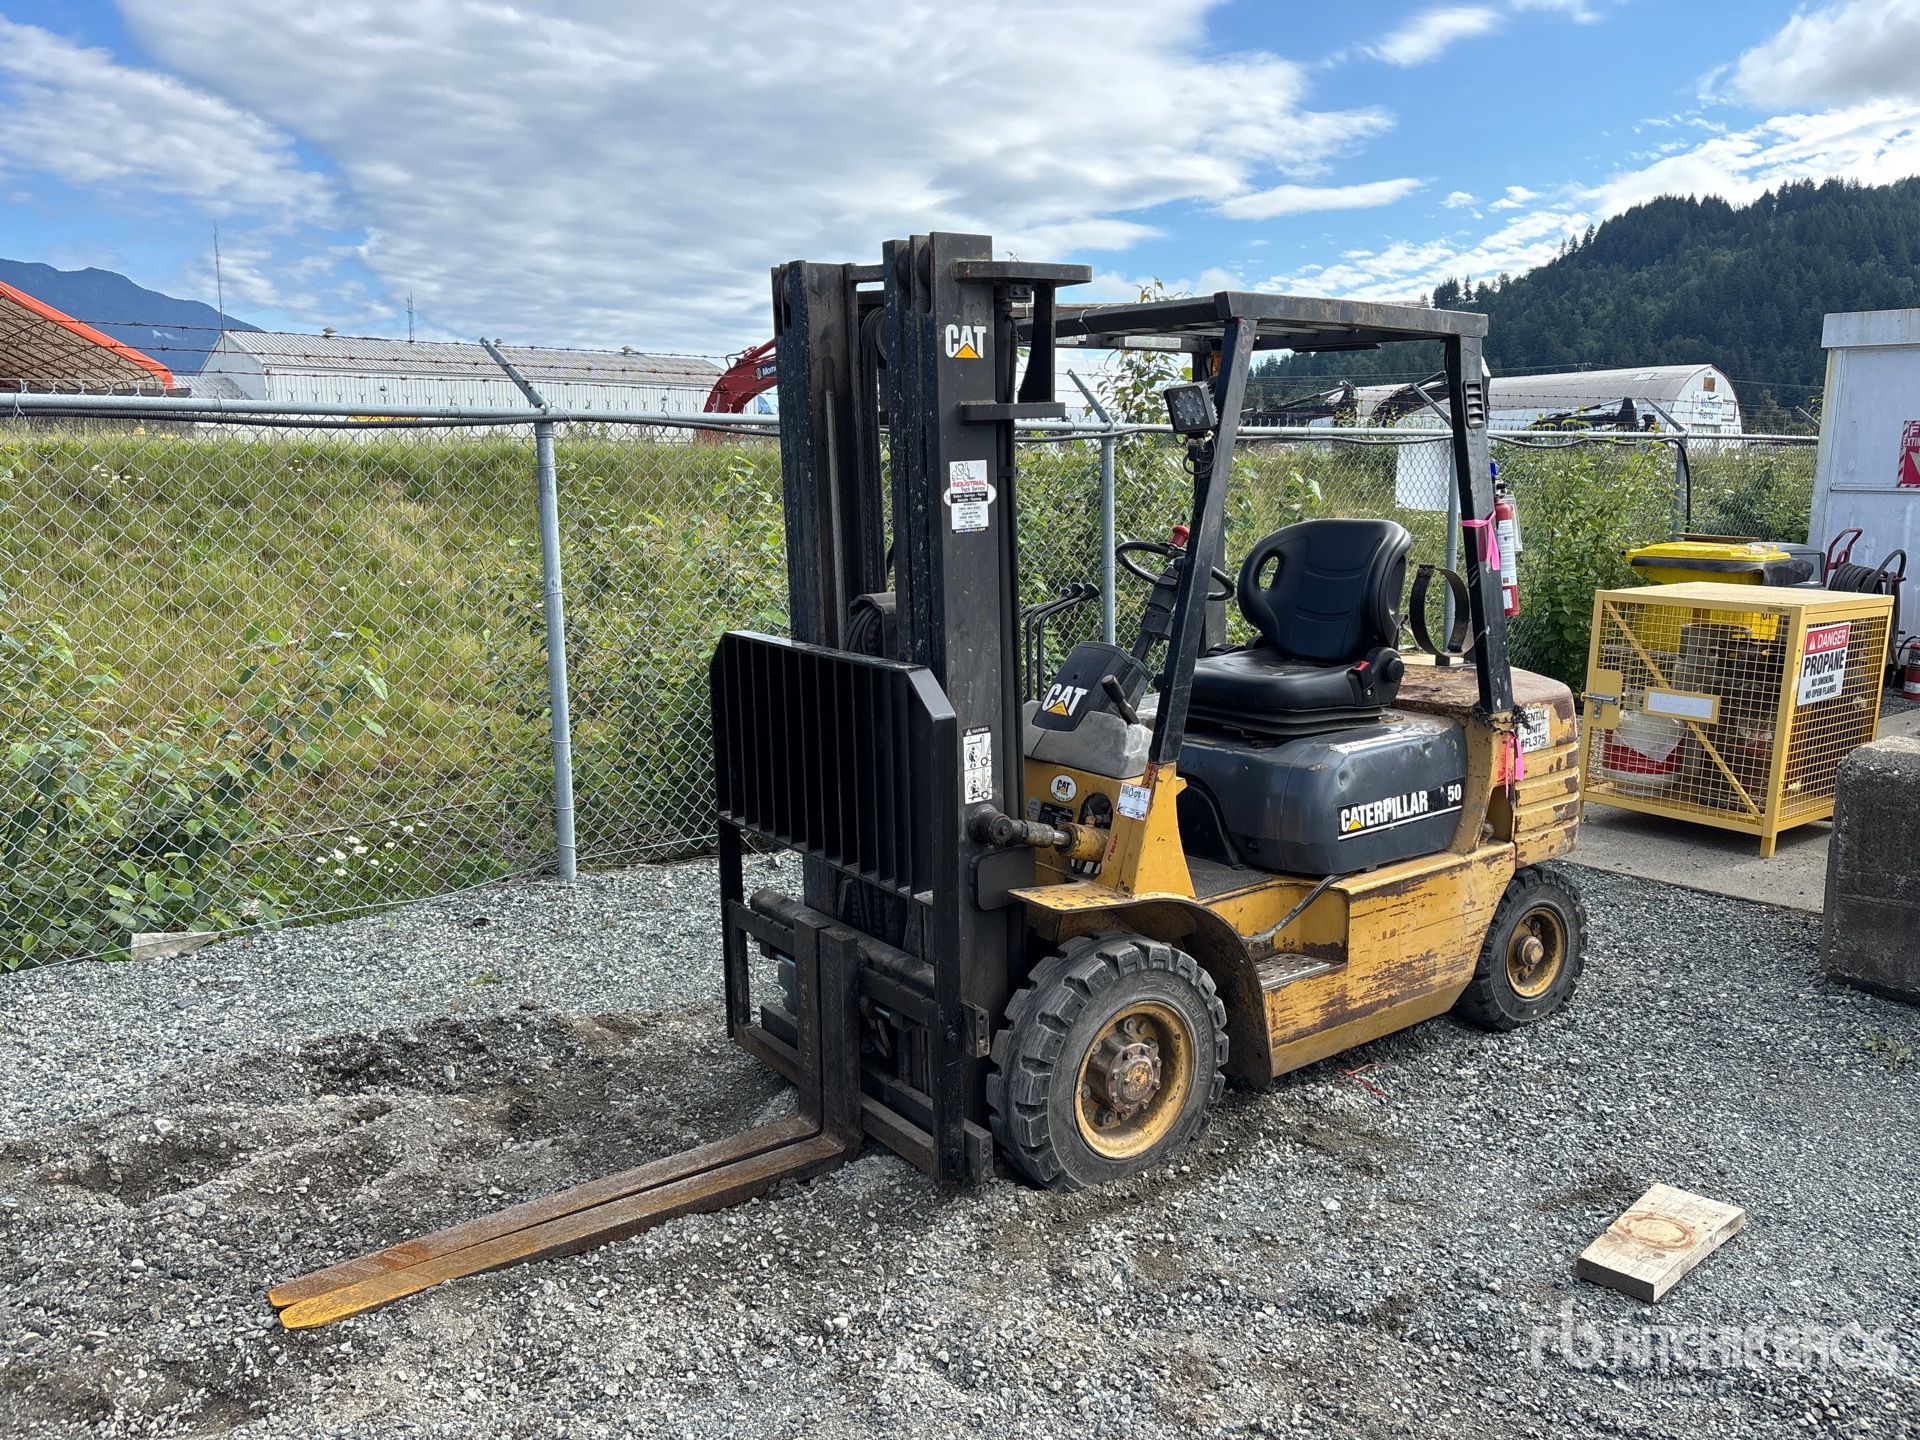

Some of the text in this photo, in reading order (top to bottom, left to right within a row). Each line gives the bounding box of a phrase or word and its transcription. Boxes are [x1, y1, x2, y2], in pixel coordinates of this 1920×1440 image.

[945, 324, 987, 358] CAT
[1817, 629, 1847, 649] DANGER
[1803, 649, 1845, 677] PROPANE
[1805, 684, 1836, 699] NO OPEN FLAMES
[1811, 674, 1835, 687] NO SMOKING
[1042, 683, 1087, 716] CAT
[1521, 710, 1546, 722] ENTAL
[1057, 779, 1071, 793] CAT
[1340, 784, 1462, 832] CATERPILLAR 50
[1163, 981, 1203, 1019] solideal
